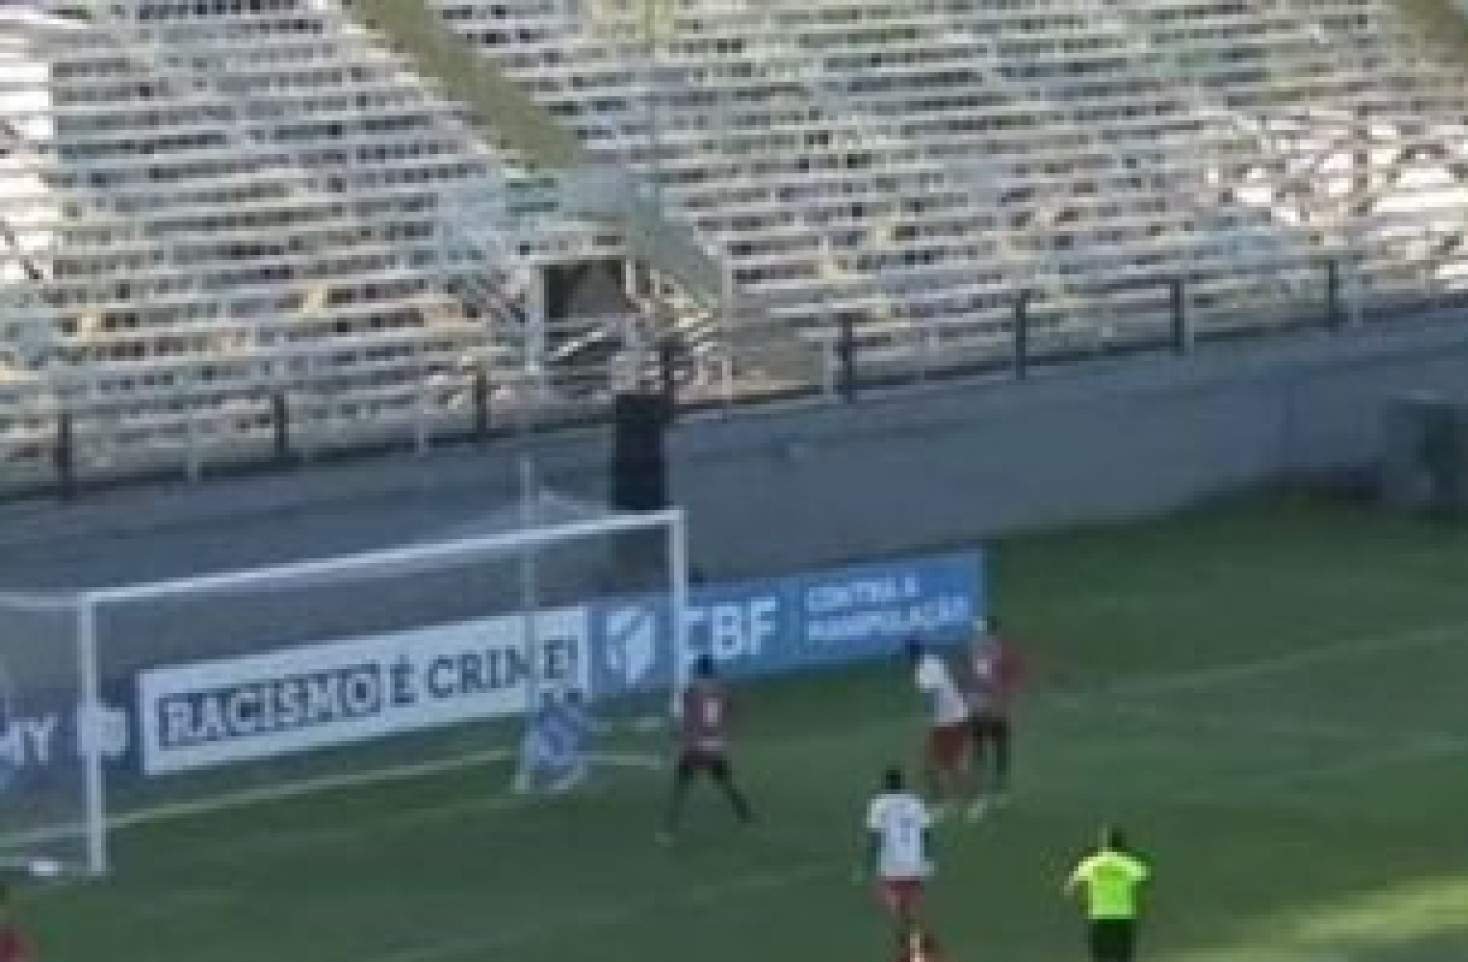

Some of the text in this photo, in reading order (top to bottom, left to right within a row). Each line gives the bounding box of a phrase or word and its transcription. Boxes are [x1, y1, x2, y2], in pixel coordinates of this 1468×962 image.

[676, 597, 777, 662] CBF
[161, 669, 379, 746] RACISMO
[390, 654, 417, 706] É
